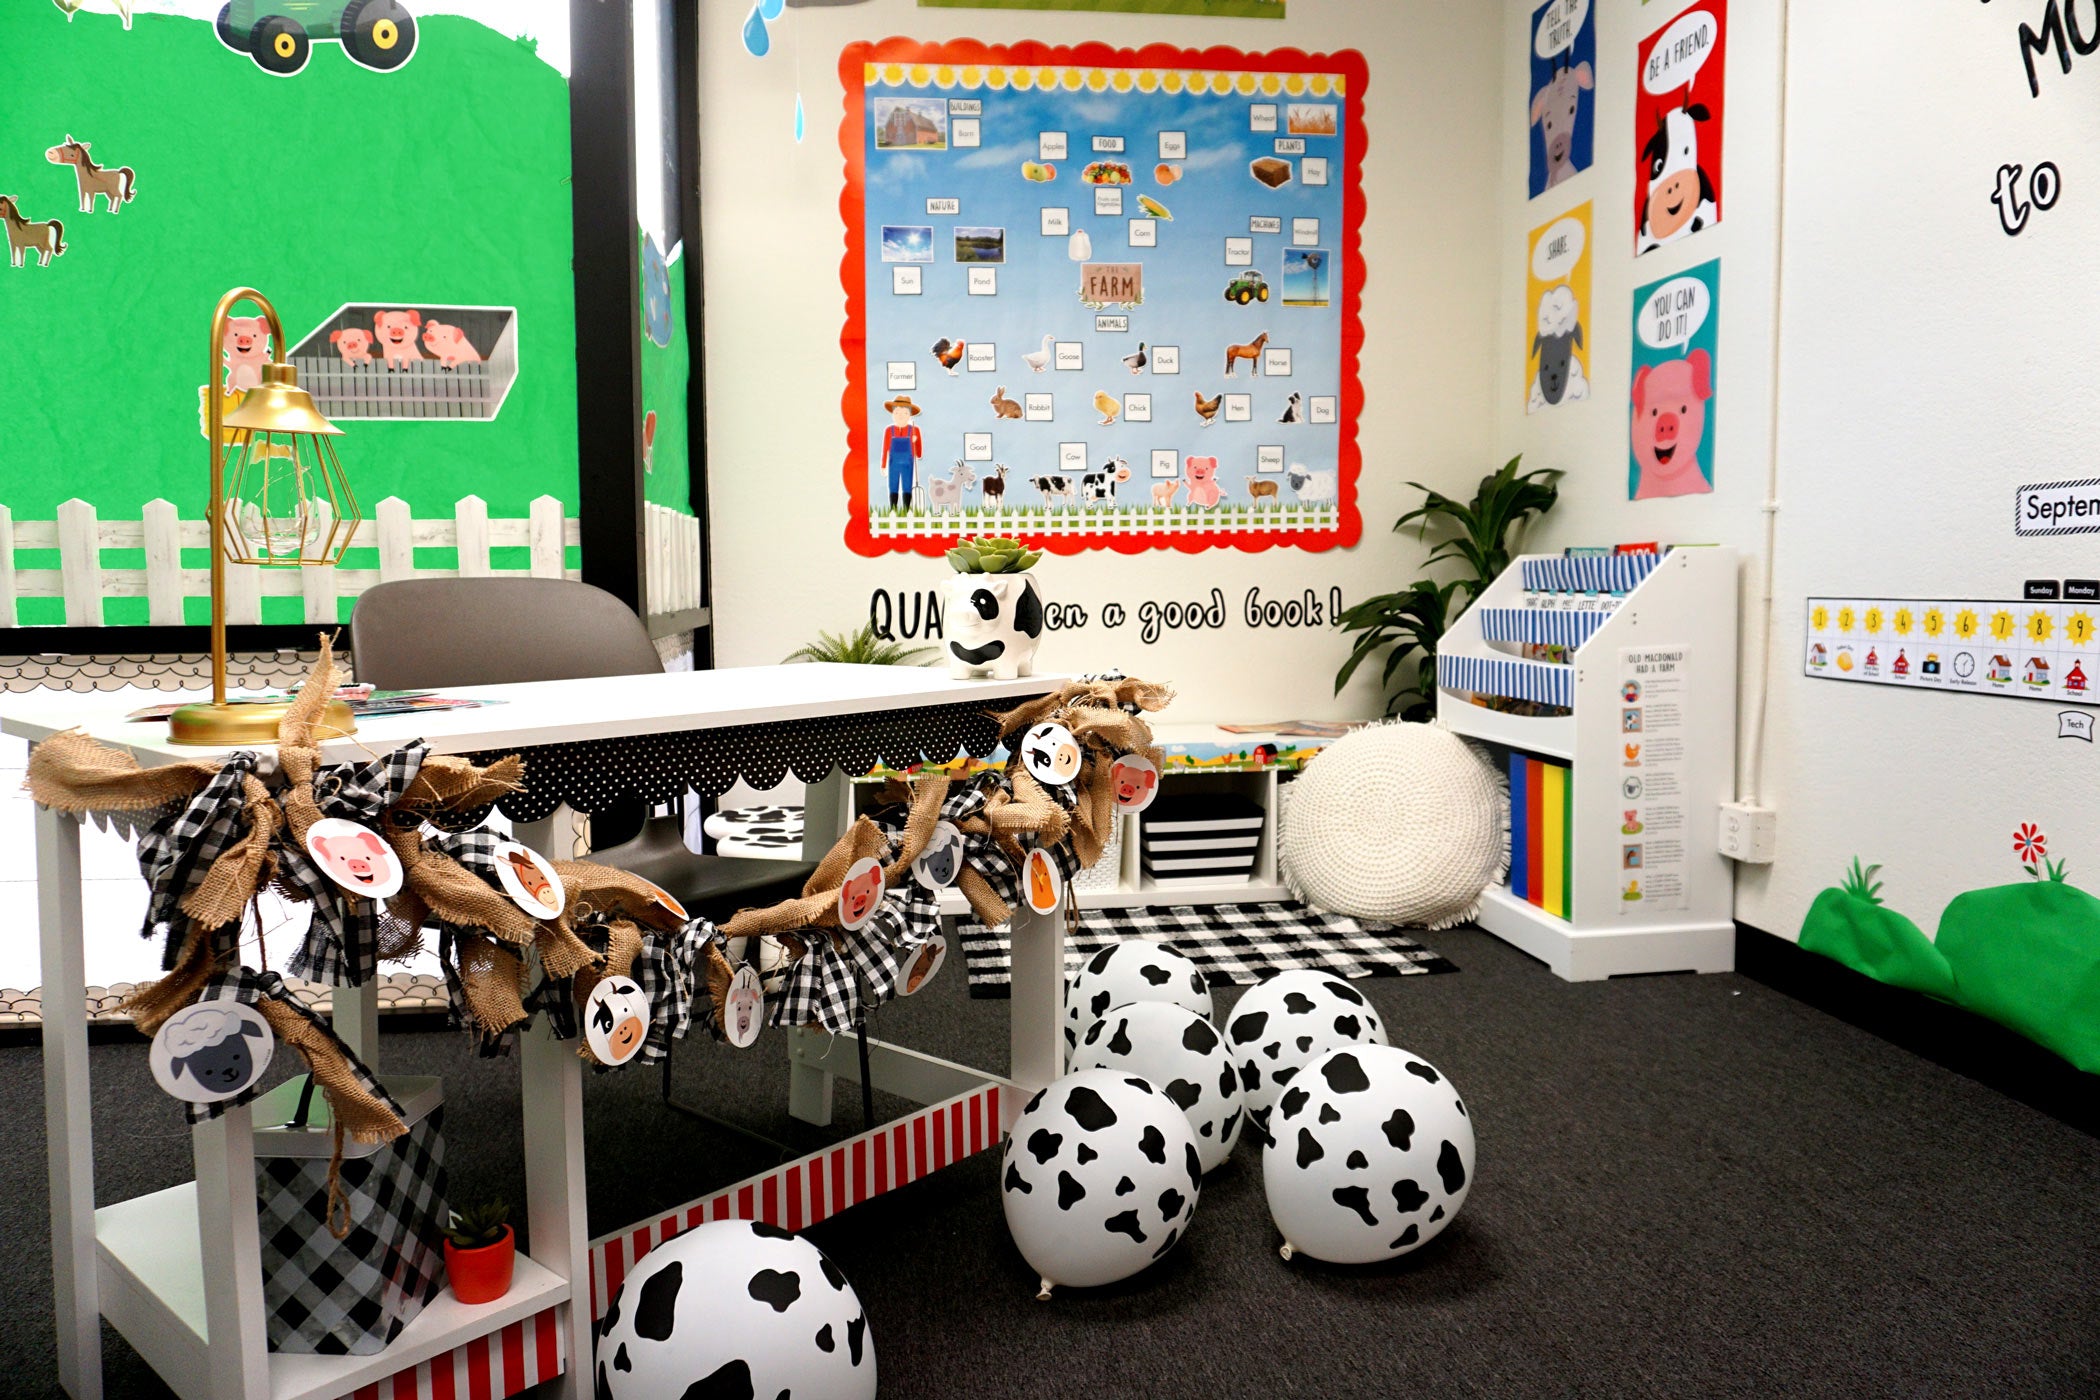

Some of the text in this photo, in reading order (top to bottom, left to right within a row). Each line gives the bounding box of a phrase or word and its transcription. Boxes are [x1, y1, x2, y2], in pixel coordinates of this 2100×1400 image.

[1546, 4, 1561, 30] TELL
[1649, 24, 1710, 81] BE A FRIEND.
[949, 102, 981, 112] BUILDINGS
[1253, 114, 1275, 122] Wheat
[958, 130, 974, 138] Barn
[1042, 142, 1065, 151] Apples
[1098, 139, 1117, 148] FOOD
[1164, 142, 1181, 151] Eggs
[1278, 141, 1301, 150] PLANTS
[1307, 168, 1321, 177] Hay
[1990, 161, 2061, 236] to
[930, 201, 956, 211] NATURE
[1047, 218, 1063, 226] Milk
[1251, 220, 1280, 230] MACHINES
[1134, 229, 1151, 237] Corn
[1227, 248, 1251, 256] Tractor
[901, 277, 914, 285] Sun
[973, 277, 991, 285] Pond
[1090, 275, 1134, 297] FARM
[1654, 286, 1696, 318] YOU CAN
[1097, 318, 1127, 329] ANIMALS
[1658, 313, 1688, 342] DO IT!
[969, 354, 994, 362] Rooster
[1058, 352, 1081, 361] Goose
[1157, 356, 1174, 364] Duck
[1269, 359, 1288, 367] Horse
[889, 372, 914, 381] Farmer
[1028, 404, 1051, 412] Rabbit
[1128, 404, 1147, 412] Chick
[1231, 404, 1245, 412] Hen
[1316, 406, 1330, 416] Dog
[969, 443, 987, 452] Goat
[1065, 453, 1081, 461] Cow
[1260, 455, 1281, 465] Sheep
[1159, 460, 1170, 470] Pig
[2030, 586, 2095, 596] Sunday Monday
[870, 586, 1342, 644] QUA en a good book!
[1931, 615, 1937, 631] 5
[1963, 616, 1969, 632] 6
[2000, 617, 2006, 634] 7
[2036, 618, 2042, 635] 8
[2077, 620, 2083, 638] 9
[1628, 652, 1683, 663] OLD MACDONALD
[1636, 664, 1649, 674] HAD
[1659, 663, 1676, 673] FARM
[2067, 719, 2084, 730] Tech
